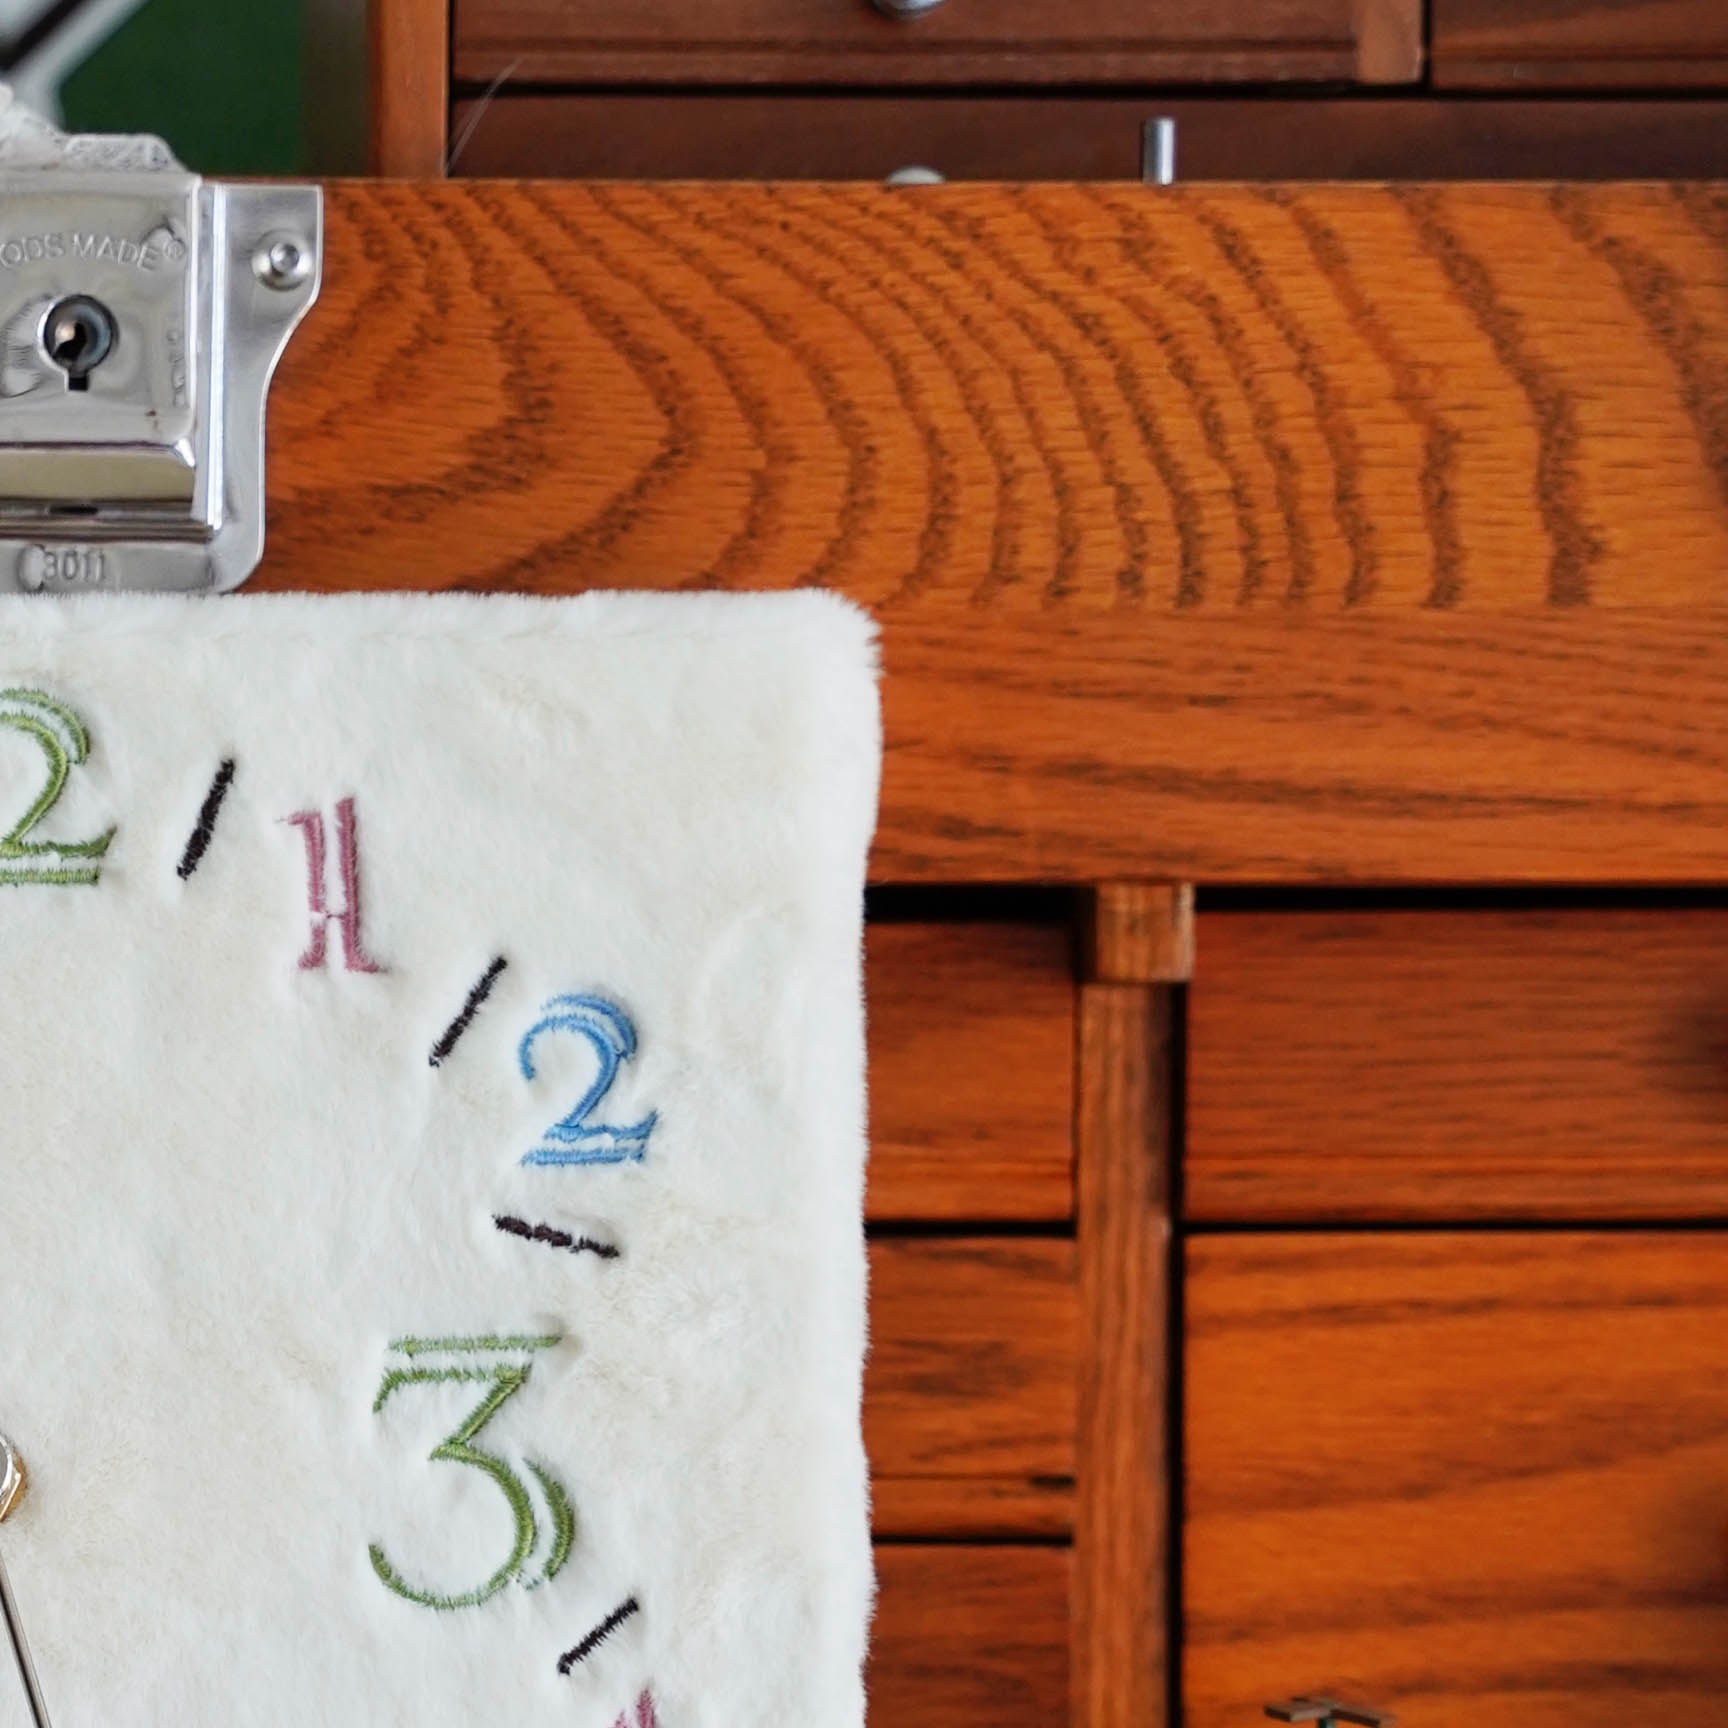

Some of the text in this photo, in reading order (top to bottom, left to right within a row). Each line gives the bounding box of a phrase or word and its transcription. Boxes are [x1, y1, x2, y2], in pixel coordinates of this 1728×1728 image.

[277, 796, 389, 975] 1
[518, 993, 659, 1166] 2
[368, 1332, 576, 1608] 3
